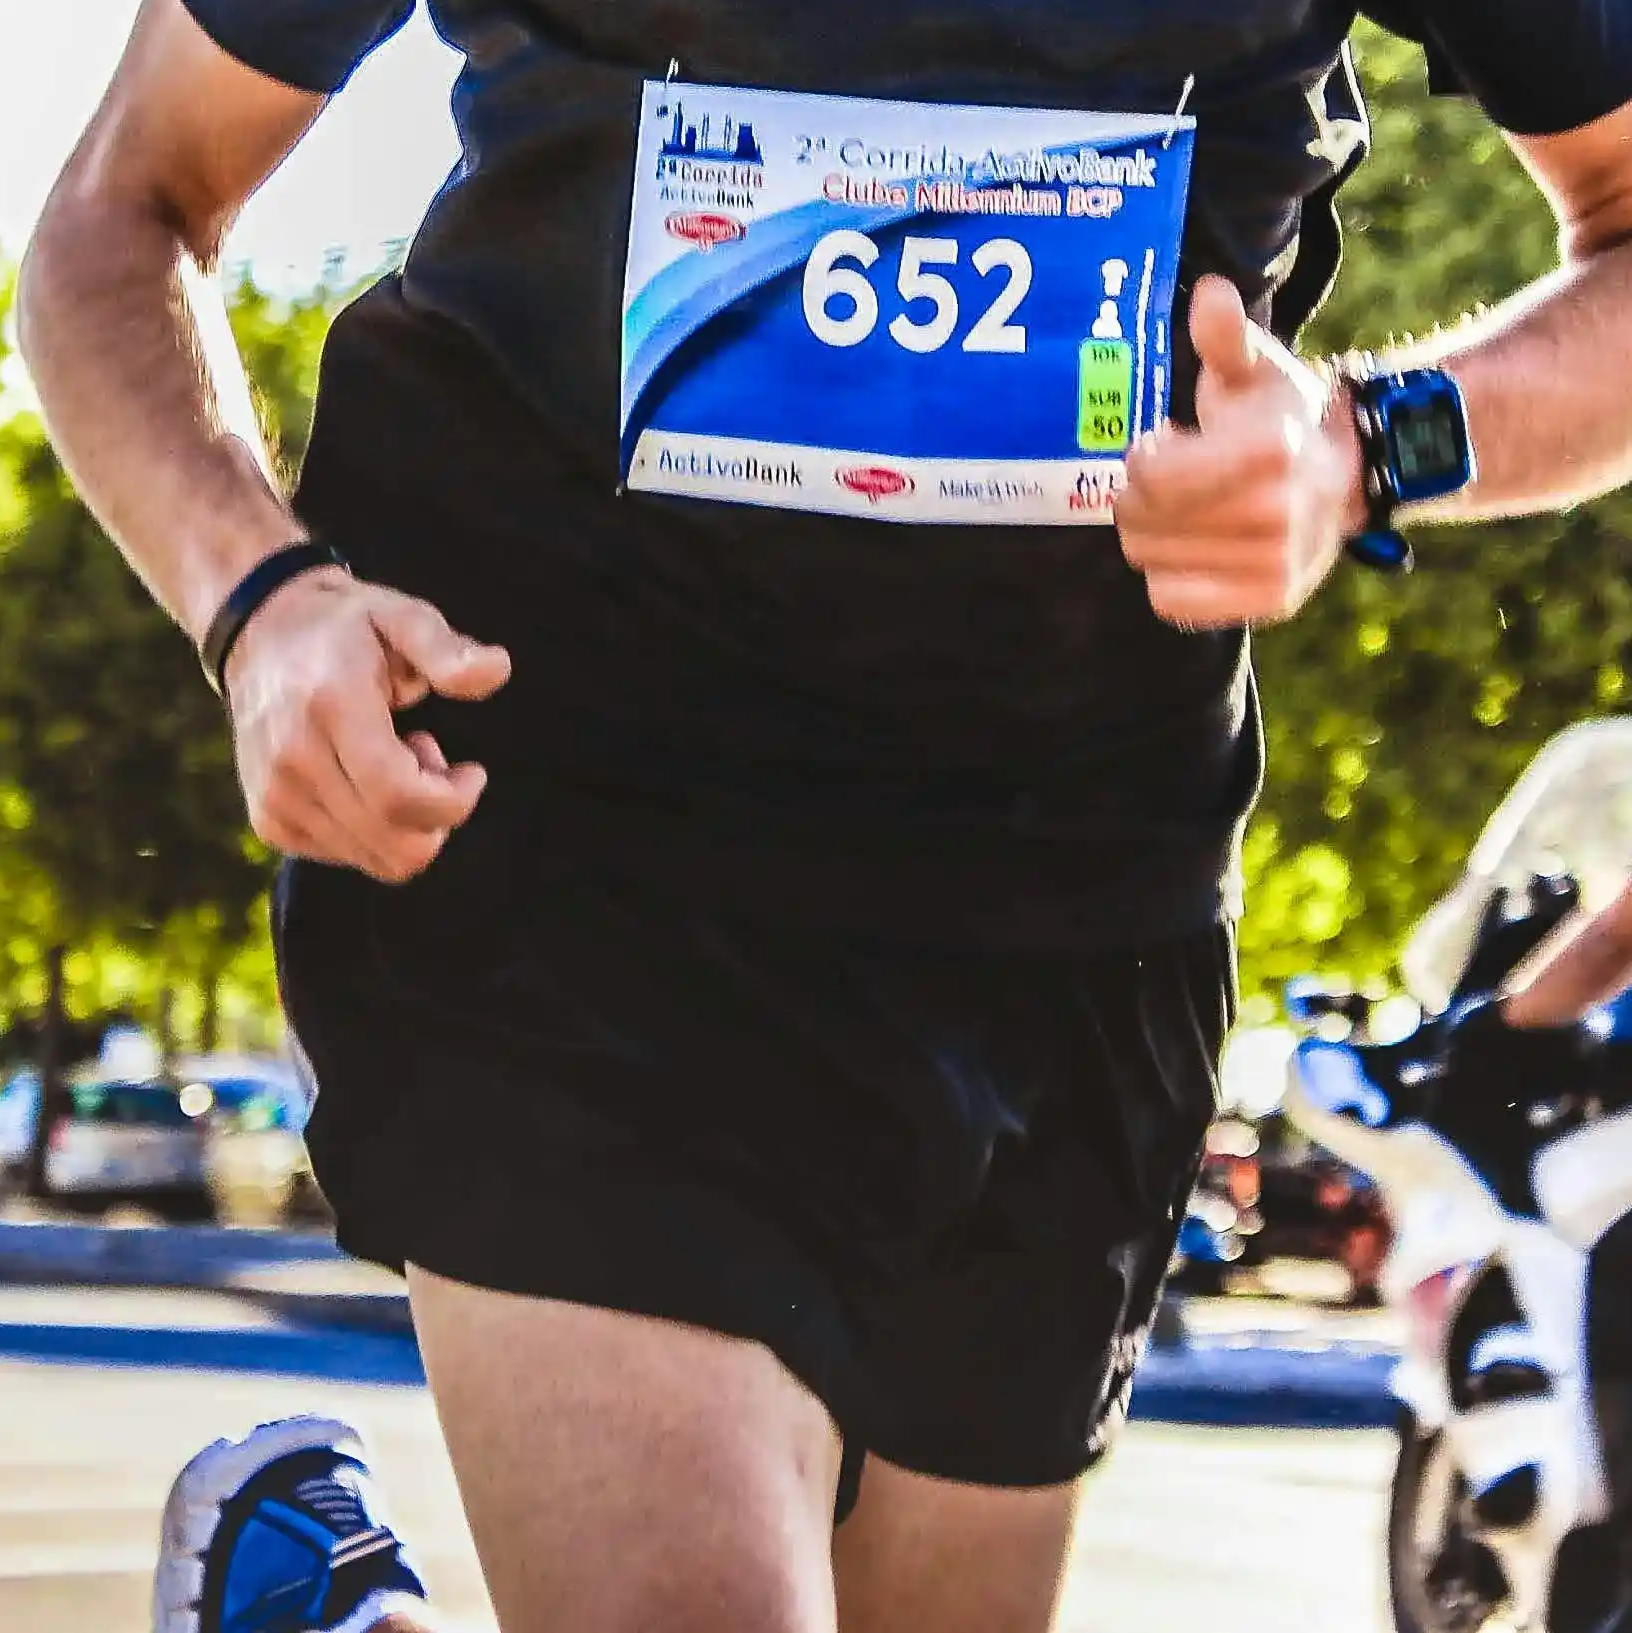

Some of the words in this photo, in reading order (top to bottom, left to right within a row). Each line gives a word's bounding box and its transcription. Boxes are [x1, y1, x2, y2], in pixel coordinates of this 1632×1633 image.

[840, 137, 965, 175] Corrida
[823, 172, 909, 209] Clube
[1066, 184, 1123, 218] BCP
[802, 229, 1033, 353] 652
[658, 446, 804, 488] ActivoBank
